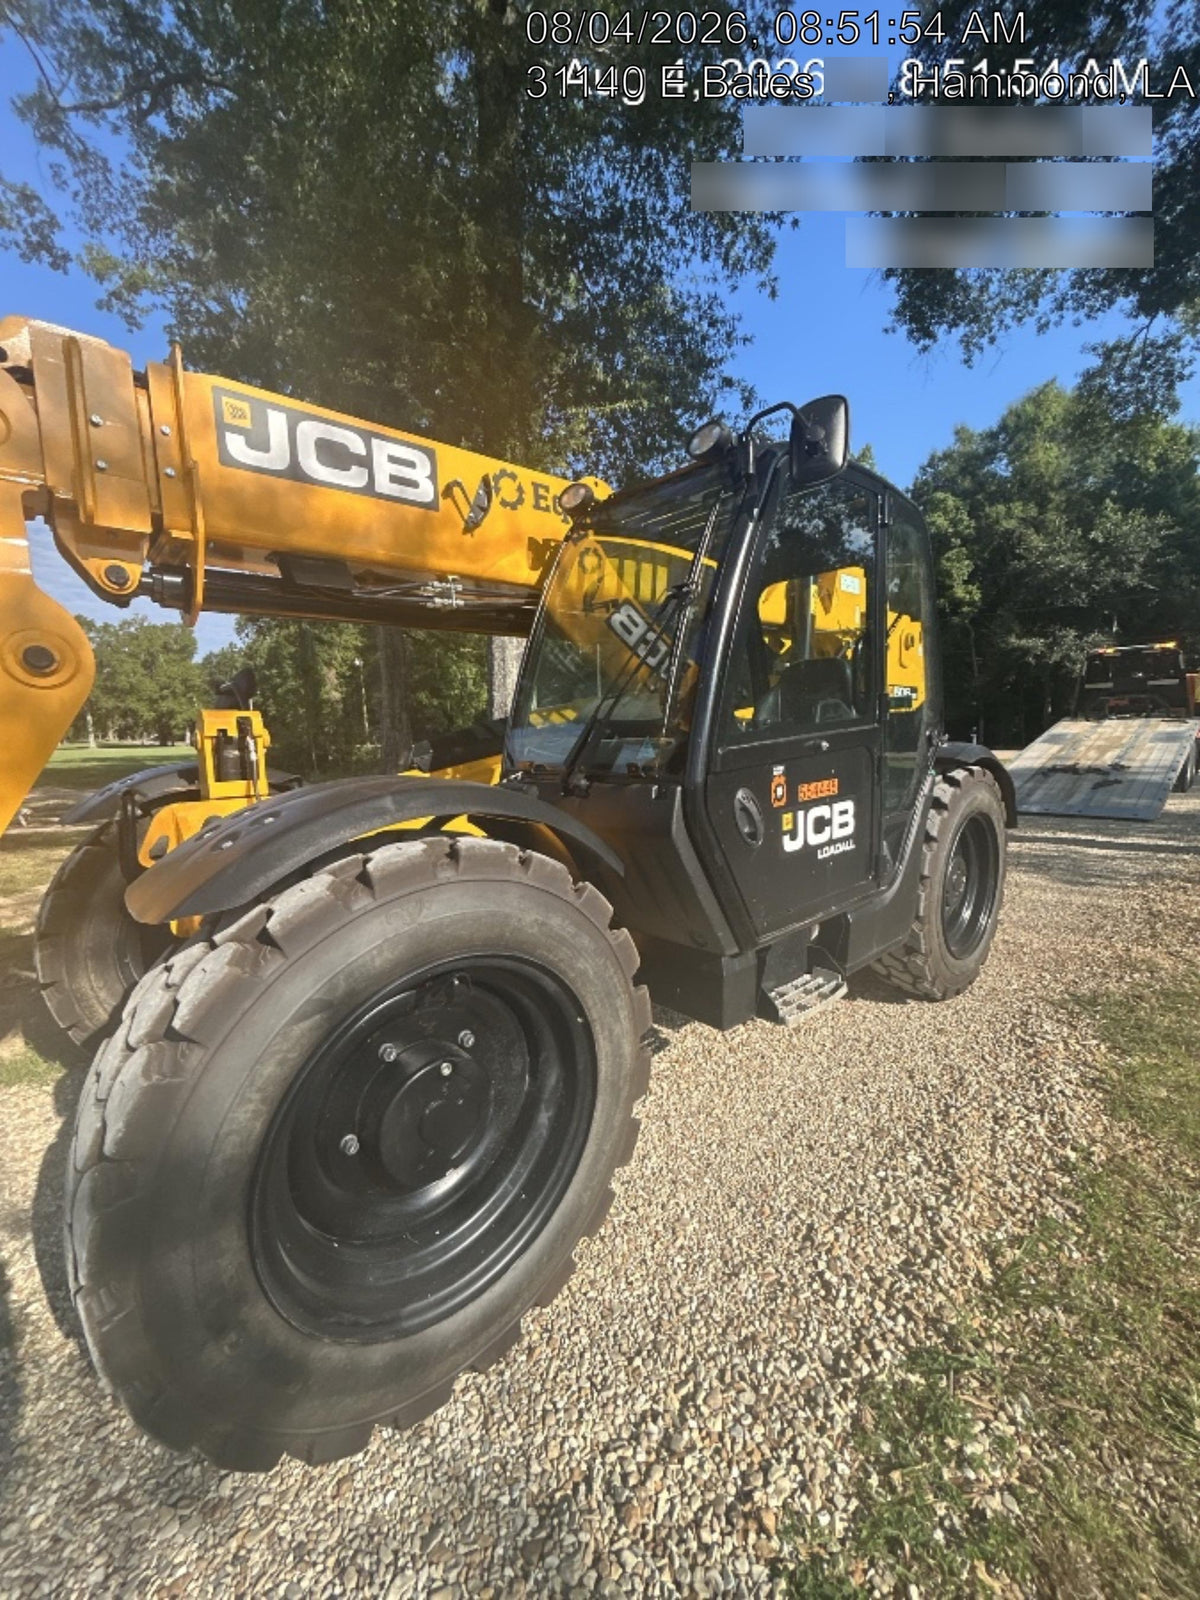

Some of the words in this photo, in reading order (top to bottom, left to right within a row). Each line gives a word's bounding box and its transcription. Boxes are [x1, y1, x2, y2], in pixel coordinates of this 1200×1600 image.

[225, 408, 435, 503] JCB
[782, 800, 855, 852] JCB
[817, 839, 856, 859] LOADALL
